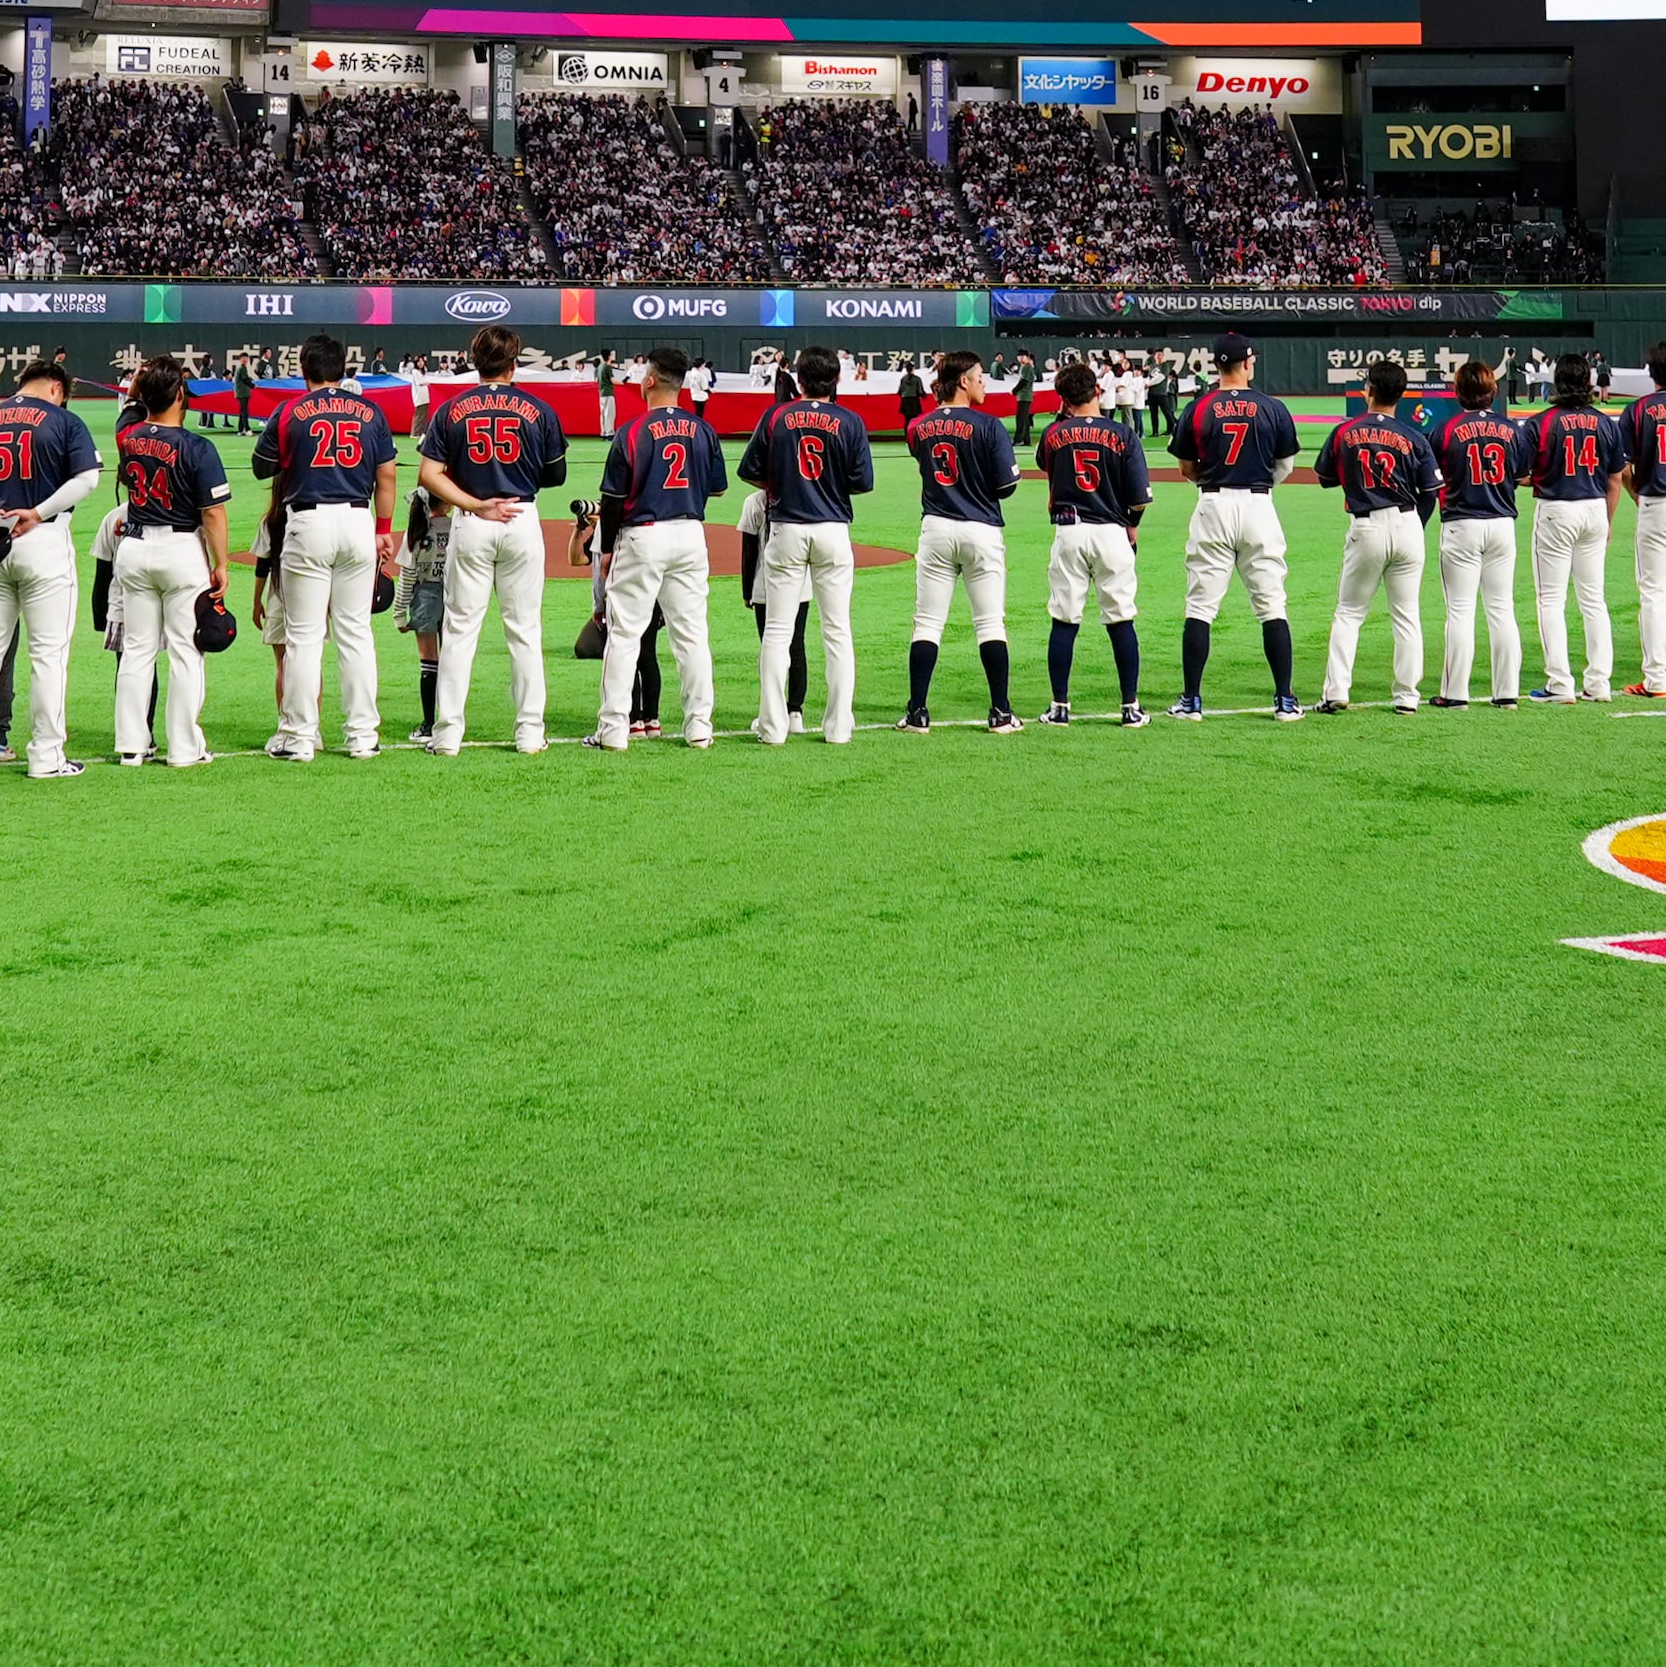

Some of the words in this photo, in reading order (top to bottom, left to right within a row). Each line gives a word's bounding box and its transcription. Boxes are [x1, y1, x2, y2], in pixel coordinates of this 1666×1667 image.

[158, 46, 221, 60] FUDEAL
[338, 51, 426, 75] 新菱冷熱
[156, 64, 221, 75] CREATION
[271, 64, 289, 81] 14
[593, 65, 664, 82] OMNIA
[804, 60, 877, 76] Bishamon
[30, 49, 47, 111] 高砂熱学
[719, 77, 729, 93] 4
[836, 80, 872, 91] スギヤス
[1023, 72, 1114, 91] 文化シャッター
[1196, 72, 1309, 99] Denyo
[496, 64, 513, 121] 阪和興業
[1142, 84, 1160, 102] 16
[1385, 125, 1512, 159] RYOBI
[52, 303, 107, 314] EXPRESS
[53, 293, 107, 304] NIPPON
[245, 294, 294, 316] IHI
[449, 295, 507, 314] Kowa
[668, 299, 727, 317] MUFG
[826, 299, 922, 318] KONAMI
[1138, 295, 1198, 311] WORLD
[1200, 295, 1283, 311] BASEBALL
[1284, 296, 1355, 312] CLASSIC
[1360, 297, 1413, 312] TOKYO
[1418, 296, 1442, 312] dip
[293, 397, 375, 423] OKAMOTO
[449, 393, 541, 425] MURAKAMI
[1212, 400, 1258, 419] SATO
[648, 418, 698, 441] MAKI
[785, 411, 842, 436] GENDA
[1560, 413, 1599, 432] ITOH
[309, 419, 365, 469] 25
[465, 416, 522, 465] 55
[1222, 422, 1250, 466] 7
[662, 442, 690, 490] 2
[797, 435, 825, 481] 6
[932, 442, 960, 487] 3
[1466, 442, 1506, 486] 13
[1562, 435, 1599, 477] 14
[1072, 450, 1101, 493] 5
[1356, 449, 1398, 491] 12
[126, 460, 174, 511] 34
